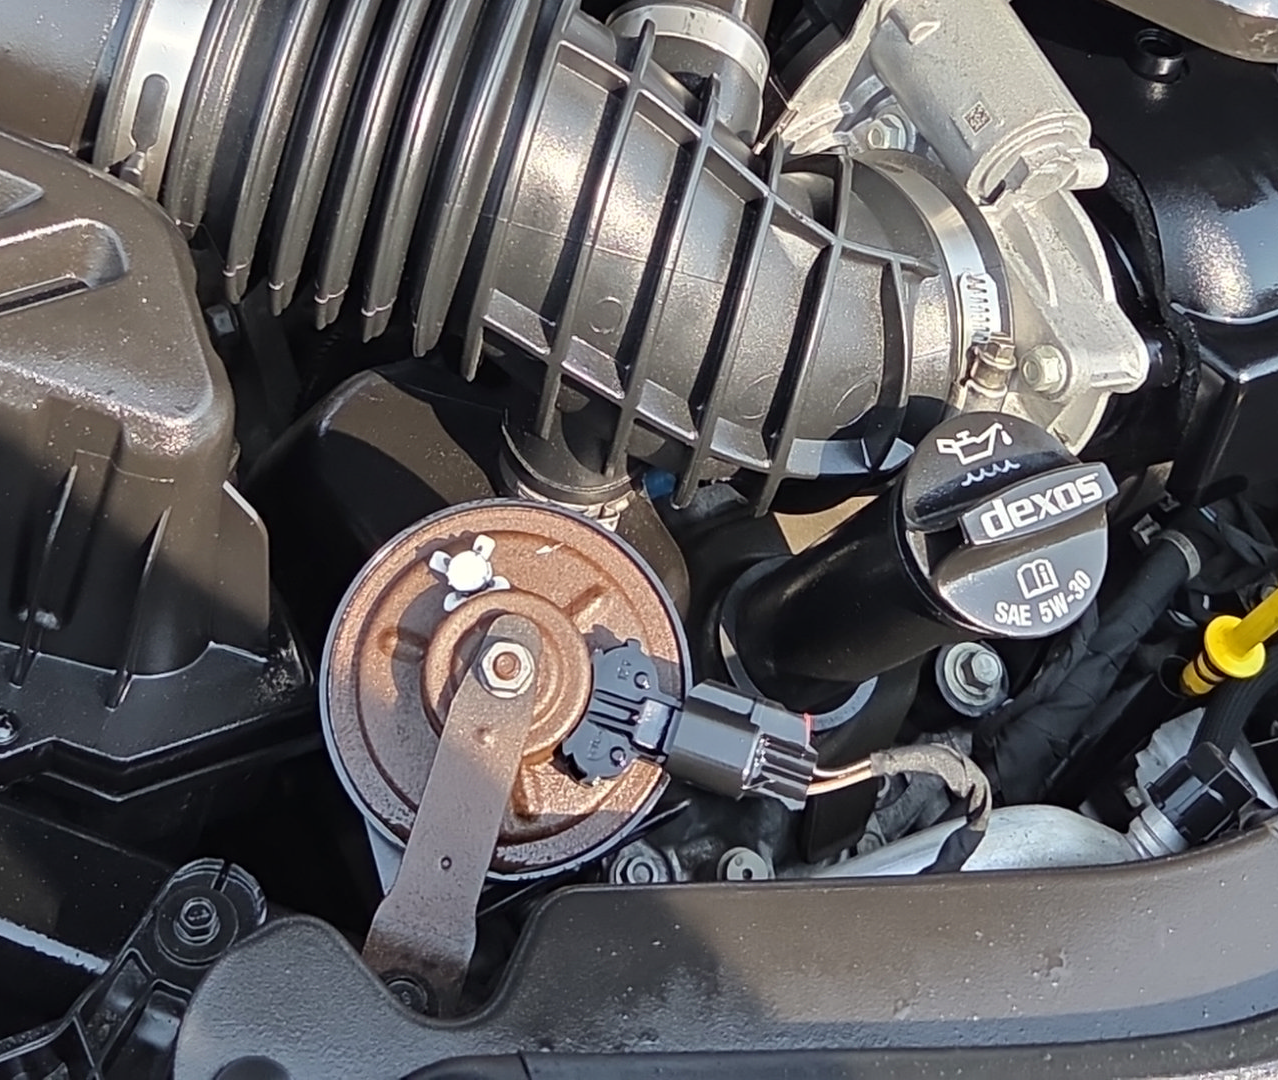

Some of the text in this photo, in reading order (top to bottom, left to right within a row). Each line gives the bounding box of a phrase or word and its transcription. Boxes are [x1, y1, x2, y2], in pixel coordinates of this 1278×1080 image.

[980, 472, 1103, 539] dexos
[994, 569, 1092, 626] SAE 5W-30
